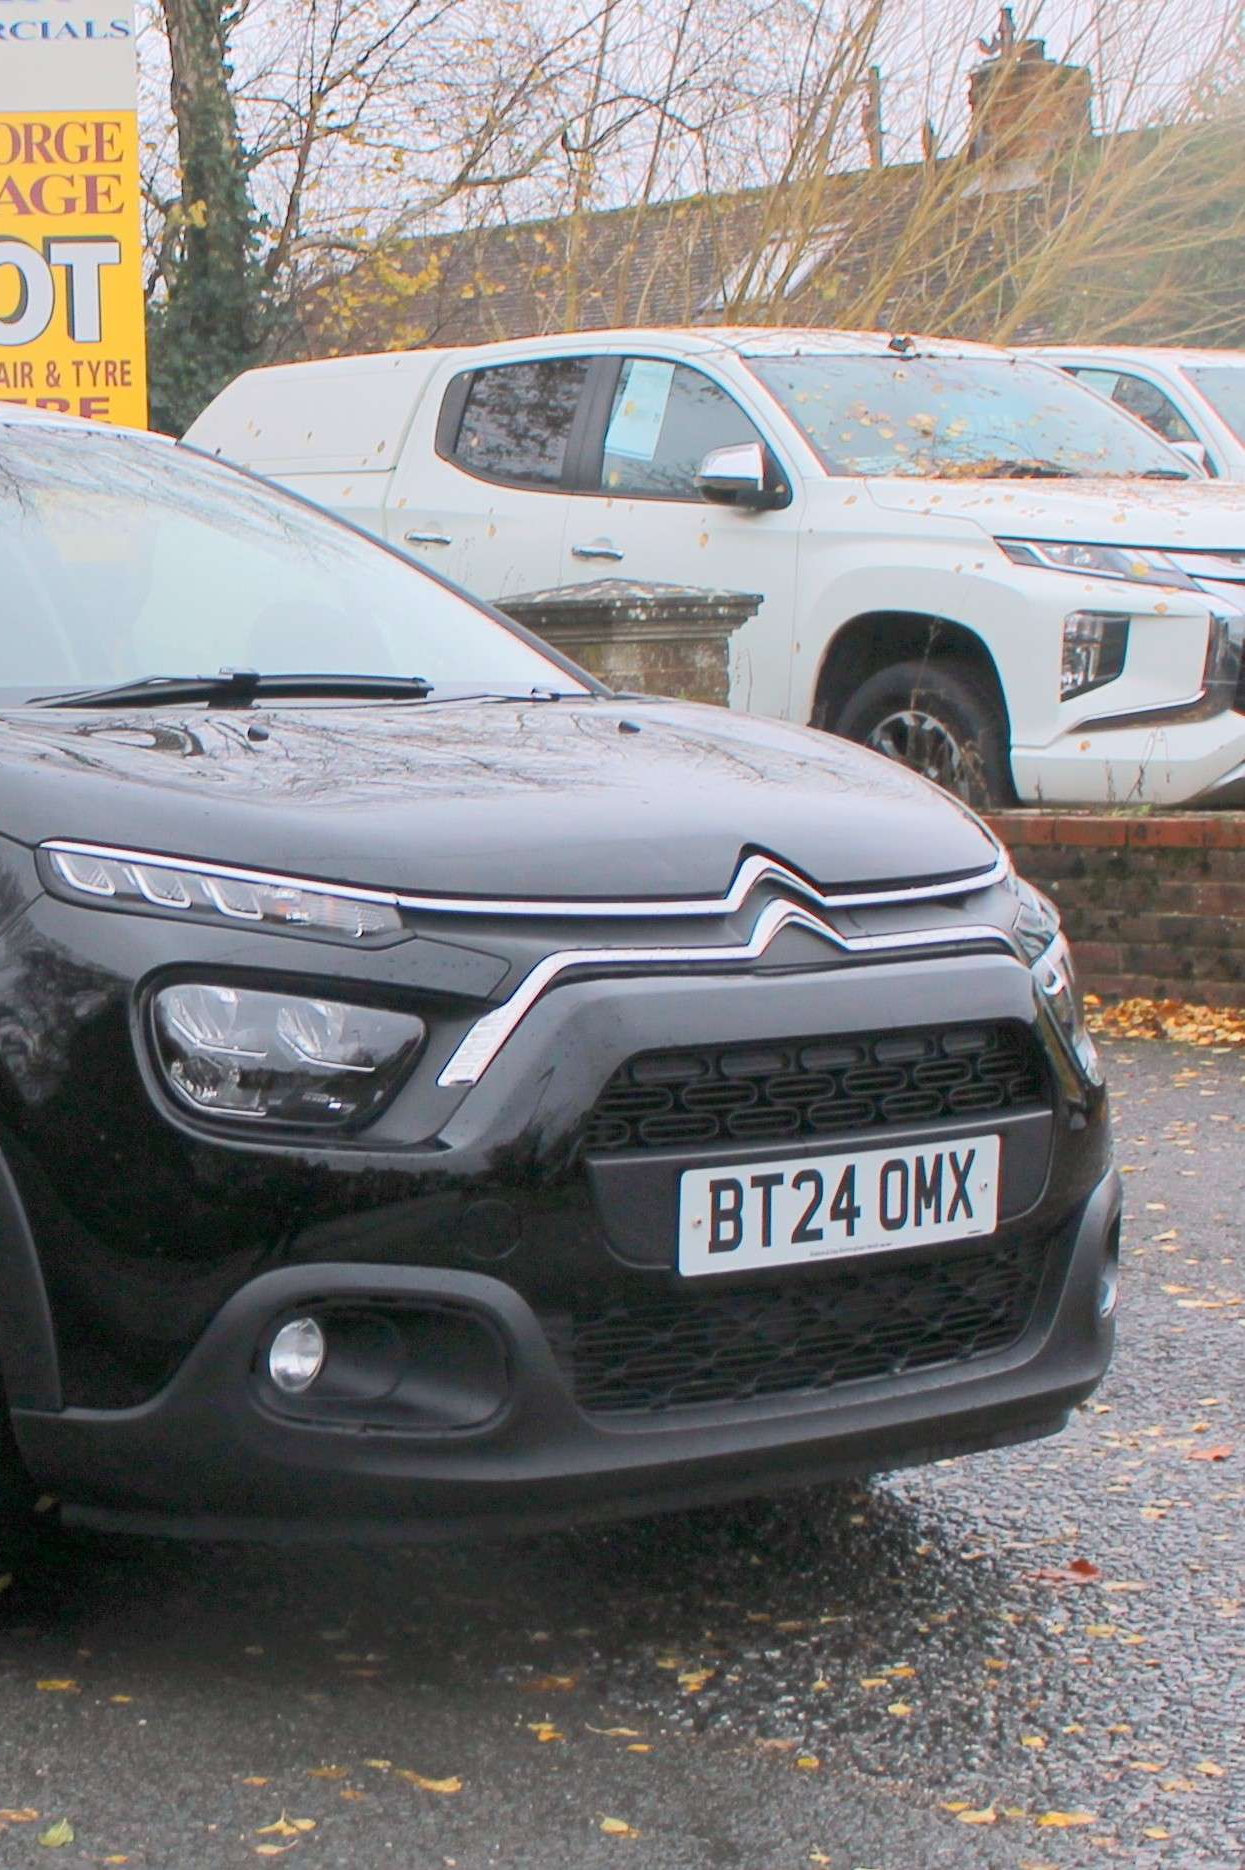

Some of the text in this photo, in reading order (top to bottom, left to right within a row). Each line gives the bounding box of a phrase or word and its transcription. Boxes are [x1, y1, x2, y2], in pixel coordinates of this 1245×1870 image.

[45, 361, 61, 388] &
[72, 359, 132, 387] TYRE
[708, 1148, 976, 1254] BT24 OMX
